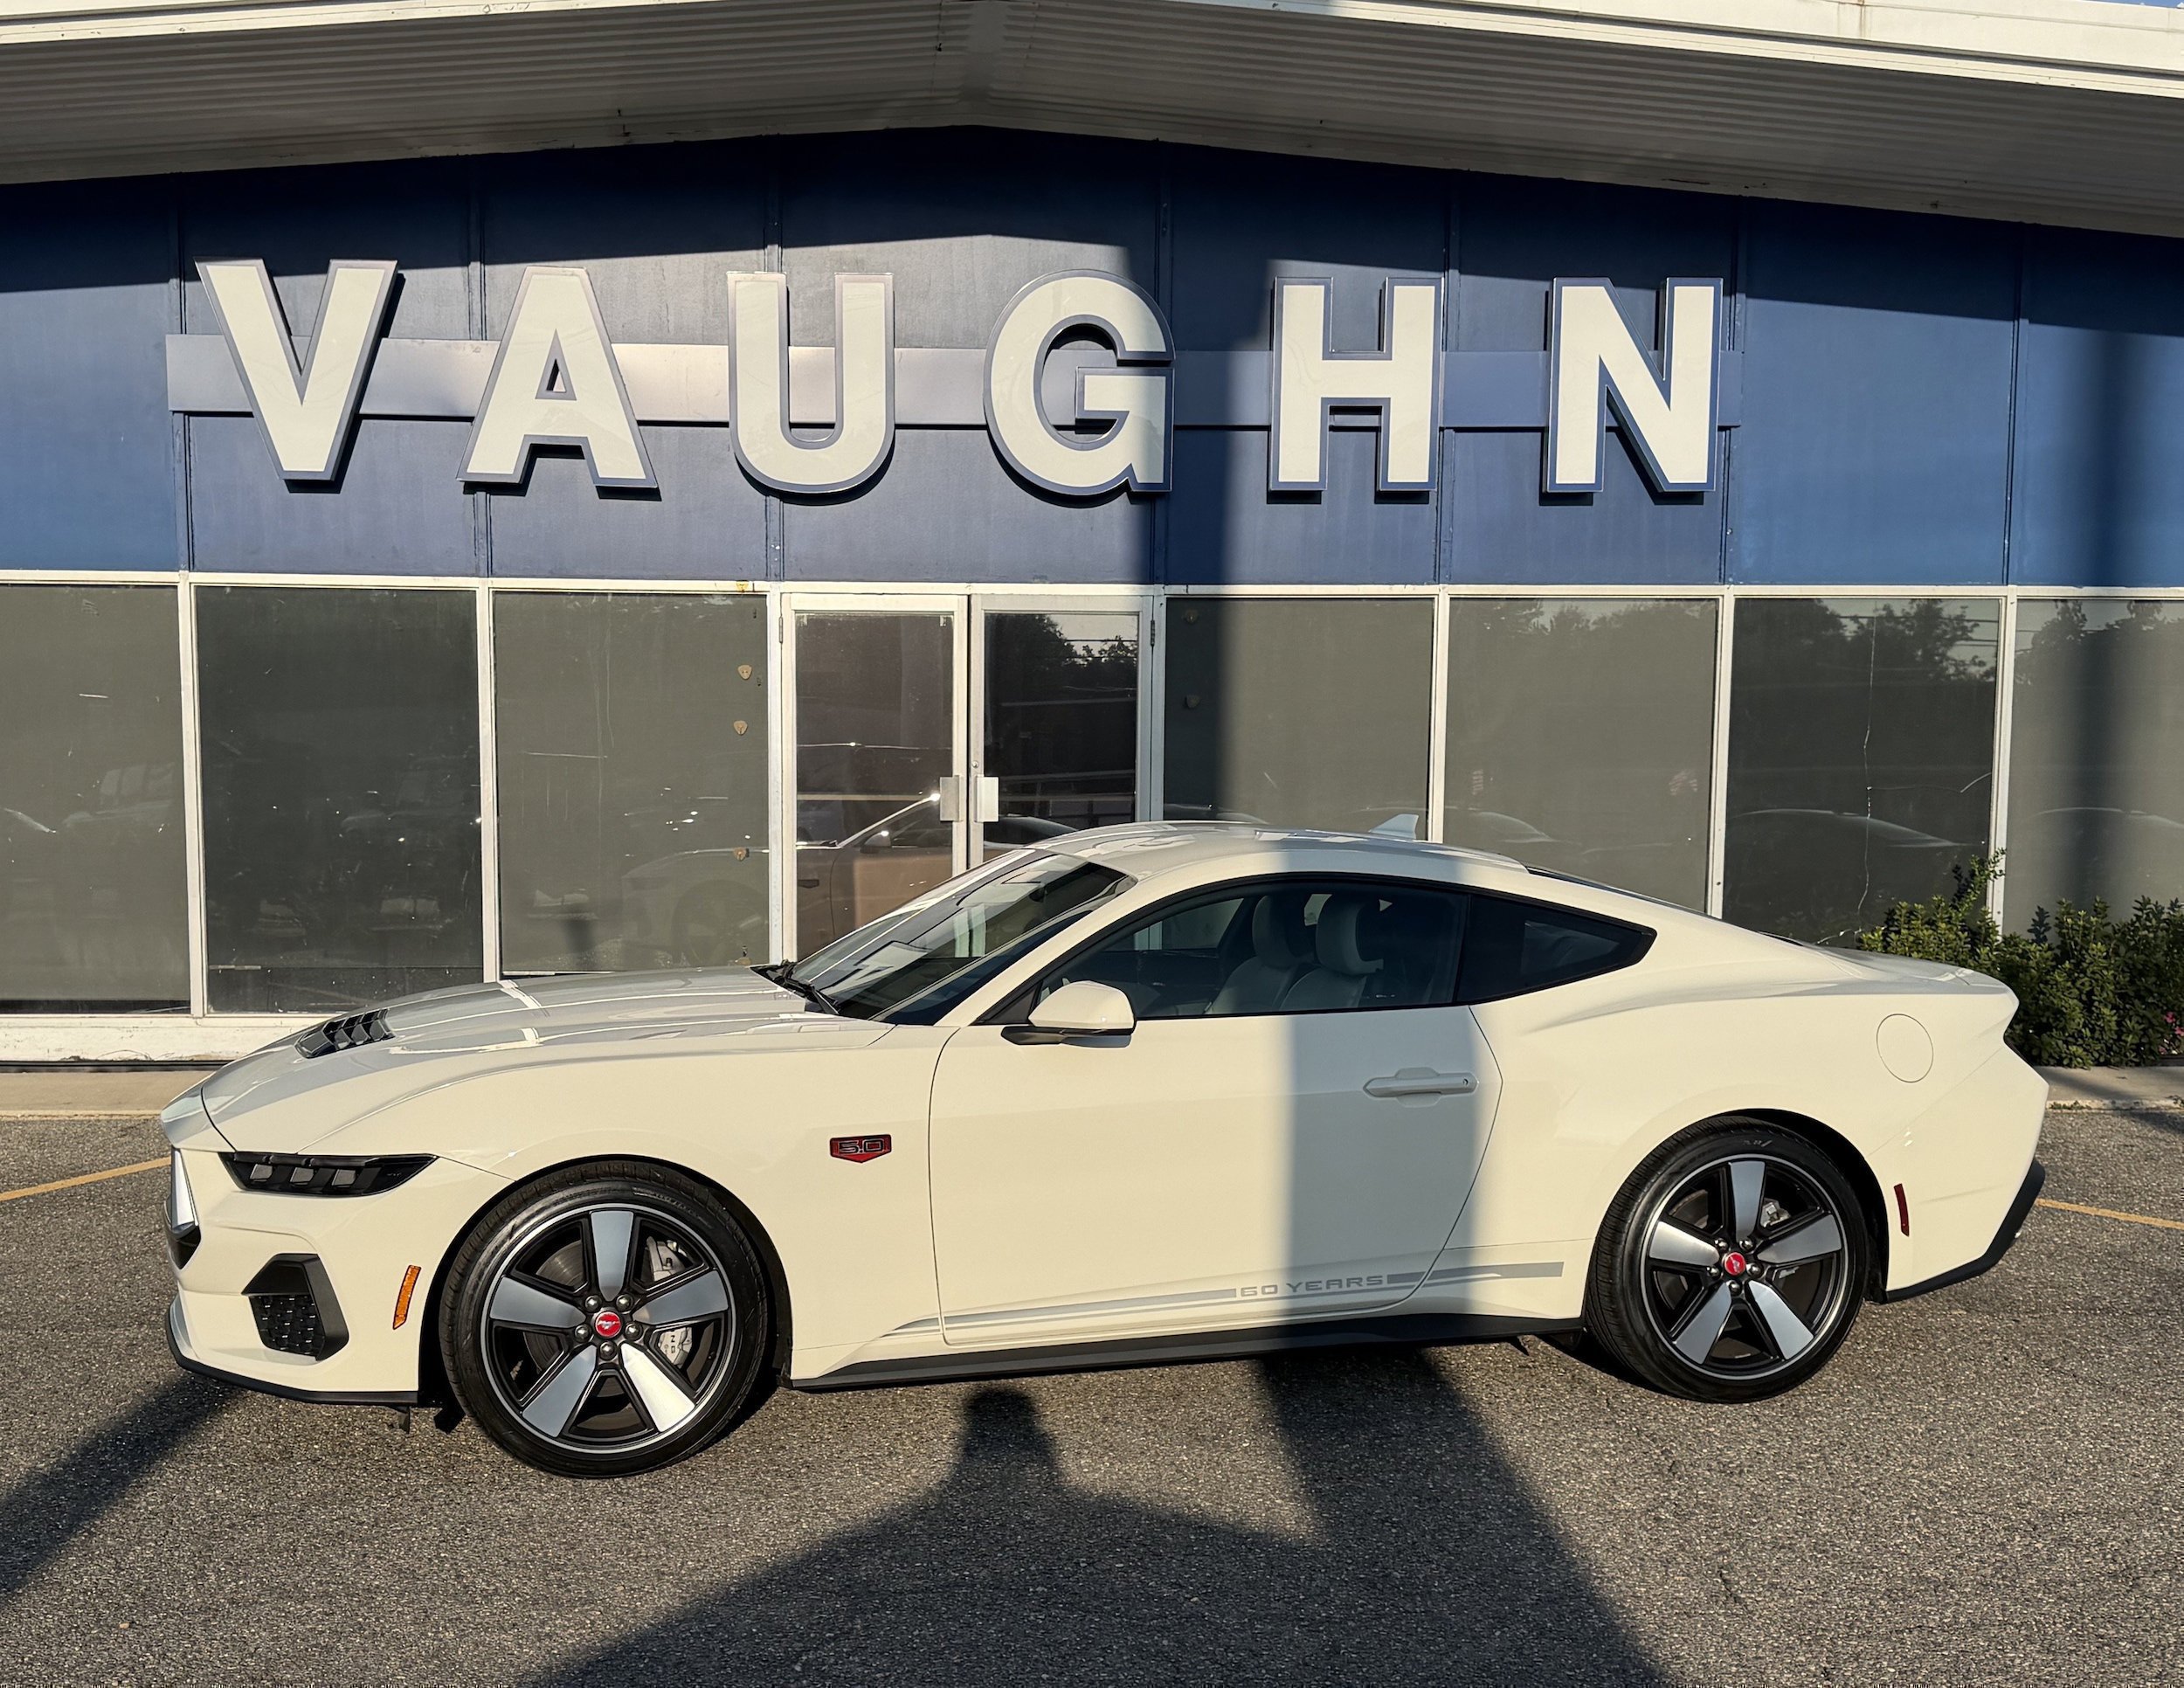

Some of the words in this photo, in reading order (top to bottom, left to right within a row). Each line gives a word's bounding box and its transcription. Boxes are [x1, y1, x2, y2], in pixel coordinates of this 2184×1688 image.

[194, 258, 1724, 495] VAUGHN
[839, 1138, 884, 1153] 5.0
[1241, 1284, 1278, 1297] 60
[1286, 1275, 1384, 1293] YEARS
